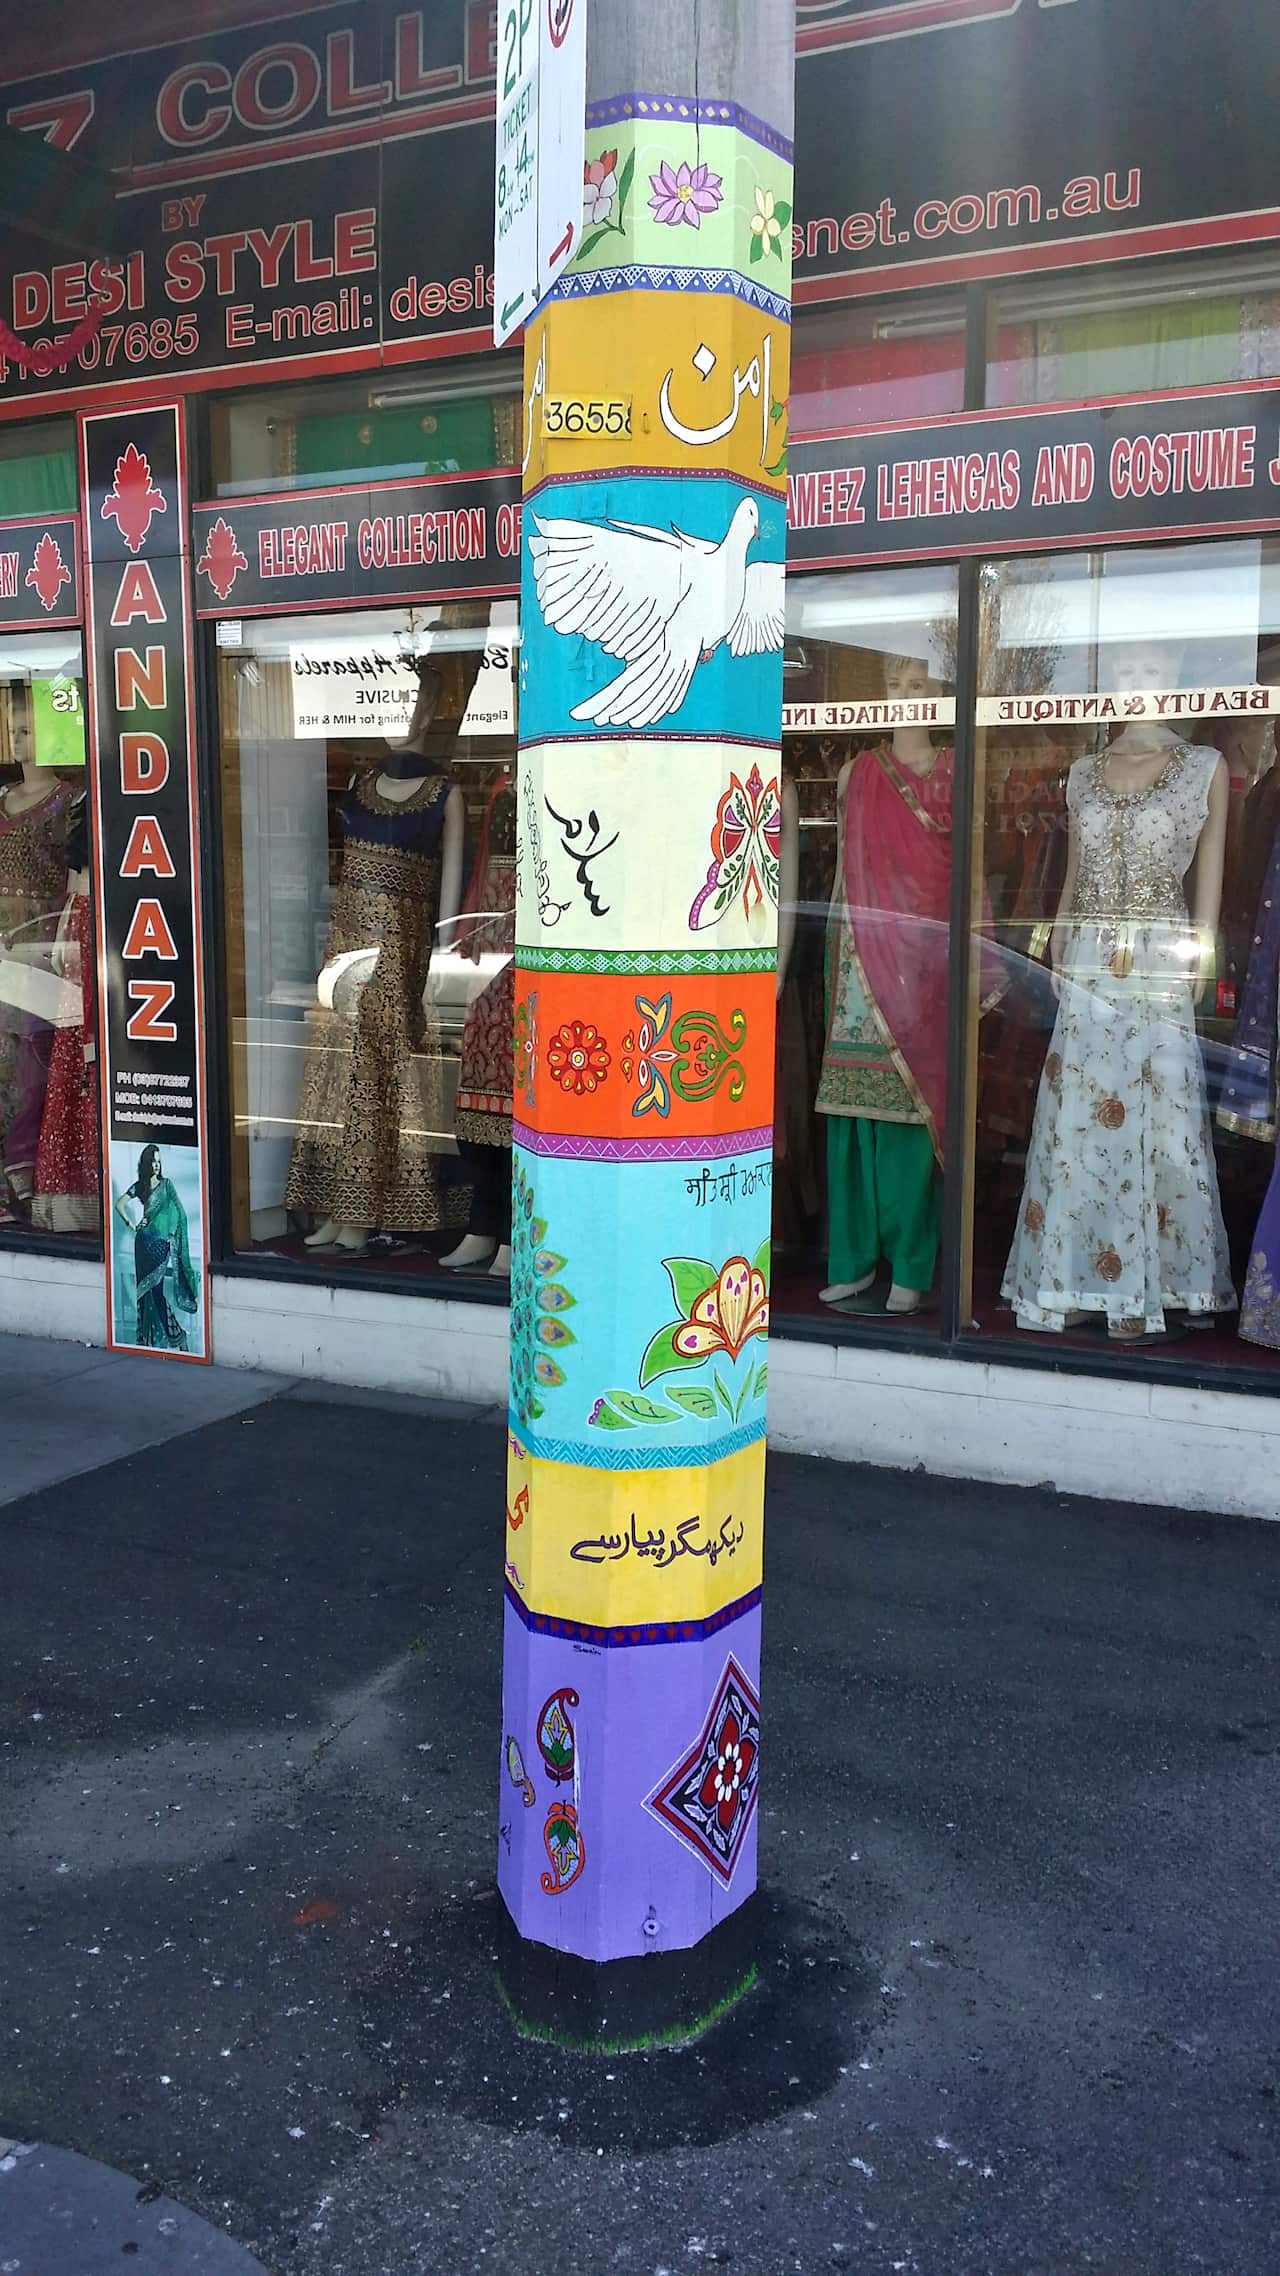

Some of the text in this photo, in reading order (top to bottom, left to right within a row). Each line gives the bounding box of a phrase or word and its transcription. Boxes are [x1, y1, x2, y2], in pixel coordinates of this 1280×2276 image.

[503, 0, 532, 100] 2P
[503, 82, 532, 149] TICKET
[162, 194, 207, 232] BY
[13, 208, 377, 330] DESI STYLE
[226, 286, 374, 349] E-mail:
[659, 333, 772, 466] امن
[258, 517, 348, 579] ELEGANT
[357, 507, 487, 571] COLLECTION
[496, 503, 523, 558] OF
[876, 449, 1022, 521] LEHENGAS
[1031, 442, 1096, 506] AND
[1109, 426, 1257, 499] COSTUME
[0, 552, 19, 598] RY
